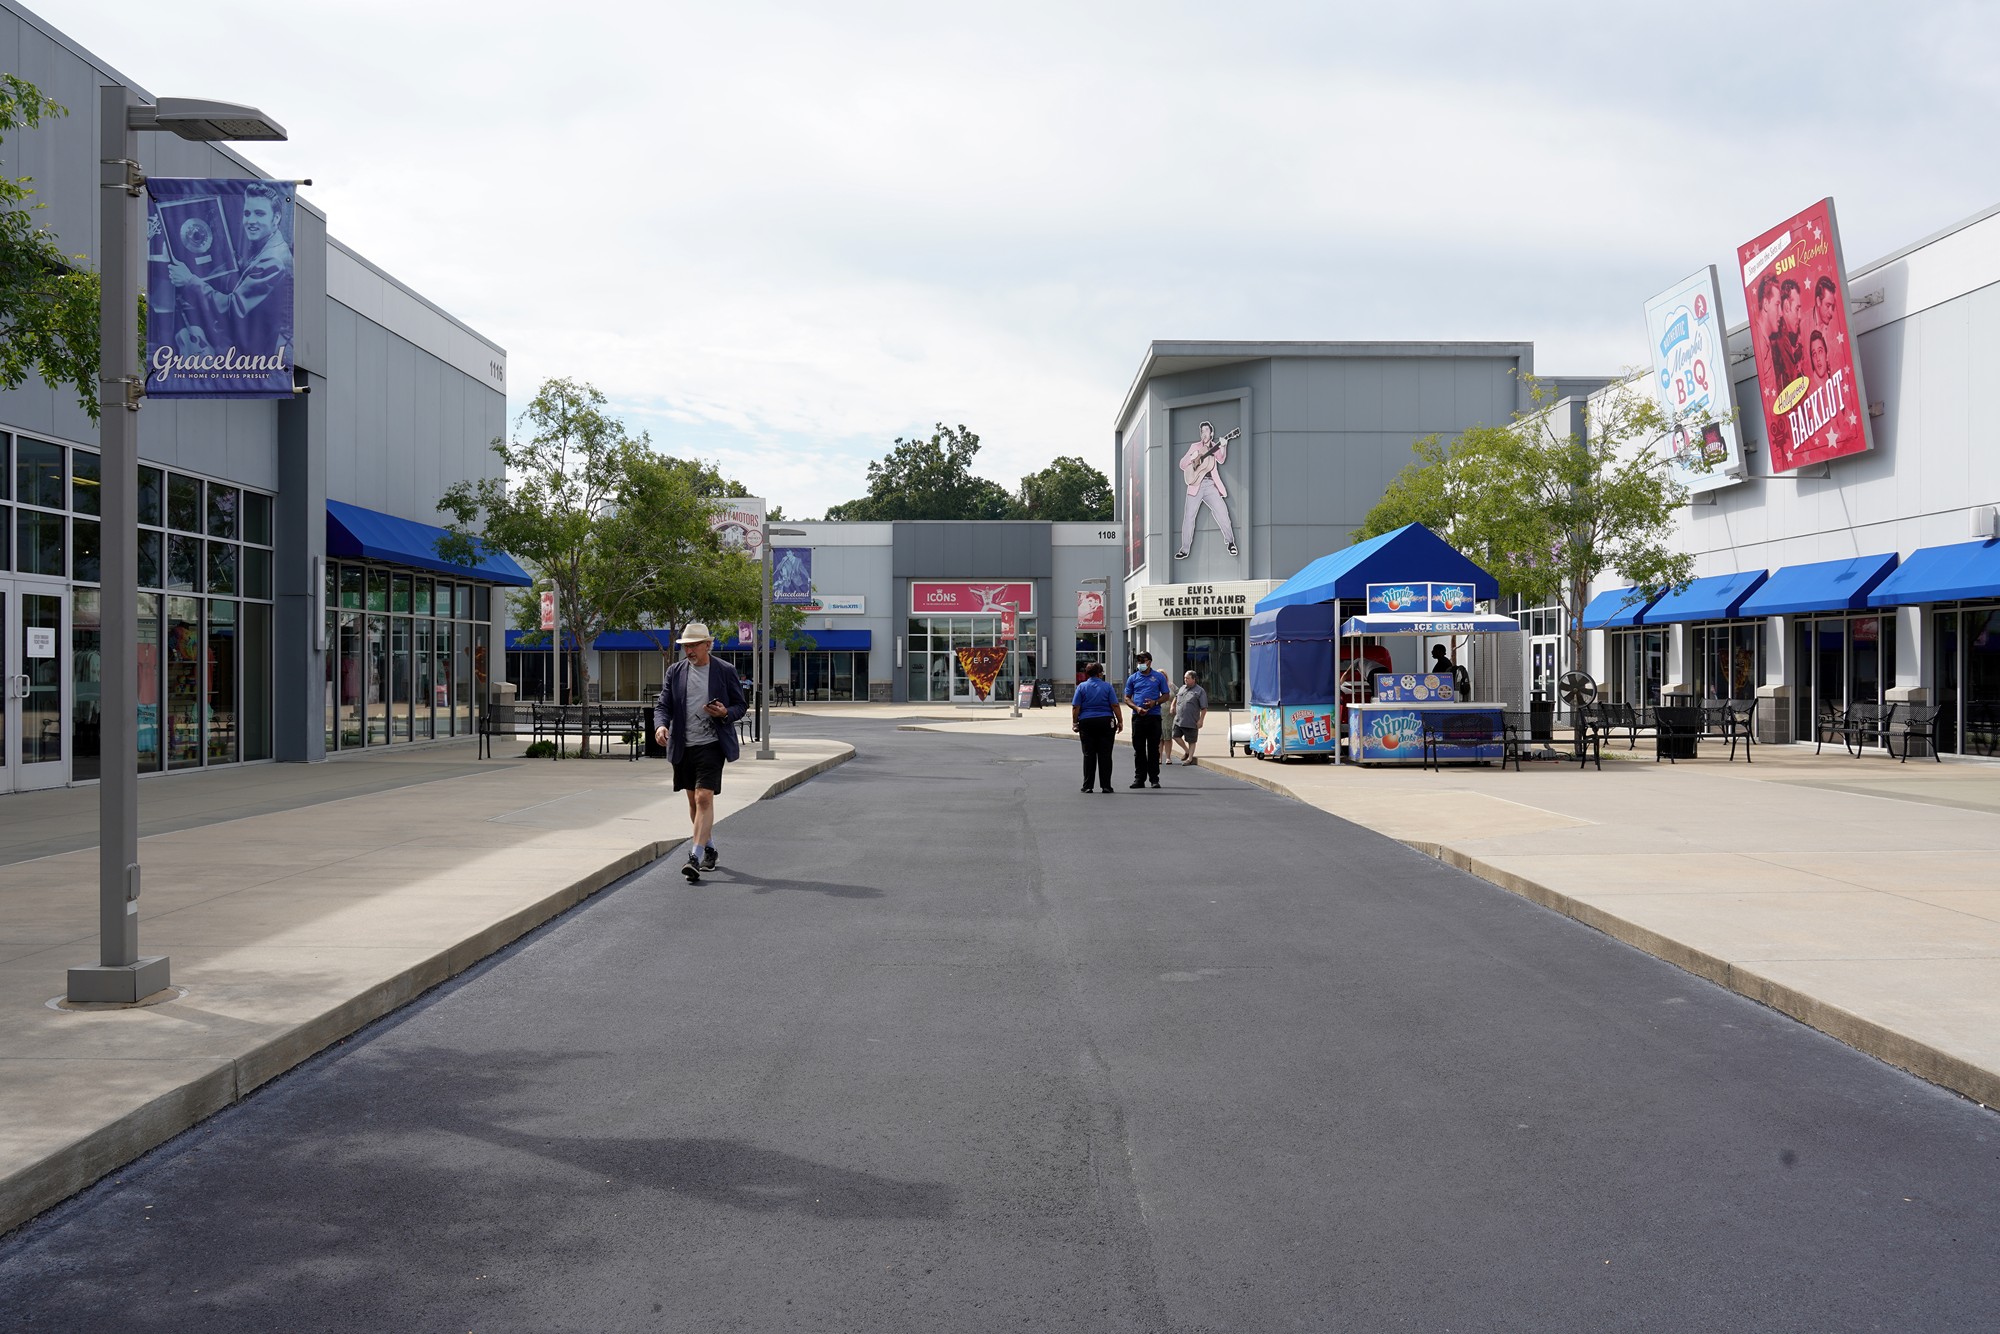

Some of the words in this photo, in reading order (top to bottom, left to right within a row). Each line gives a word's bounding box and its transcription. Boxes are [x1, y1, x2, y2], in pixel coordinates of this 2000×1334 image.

[1775, 254, 1796, 276] SUN
[1790, 234, 1829, 267] Records
[1671, 330, 1703, 378] Memphis
[152, 345, 286, 382] Graceland
[489, 359, 504, 381] 1116
[1675, 359, 1709, 404] BBQ
[1788, 369, 1845, 450] BACKLOT
[732, 511, 759, 528] MOTORS
[1098, 531, 1116, 540] 1108
[774, 590, 810, 600] Graceland
[1187, 585, 1213, 594] ELVIS
[926, 593, 957, 602] ICONS
[1158, 597, 1175, 606] THE
[1178, 595, 1246, 606] ENTERTAINER
[1163, 607, 1199, 616] CAREER
[1204, 606, 1245, 616] MUSEUM
[1414, 623, 1433, 631] ICE
[1435, 622, 1475, 631] CREAM
[1300, 720, 1329, 740] ICEE
[1398, 730, 1417, 744] dots
